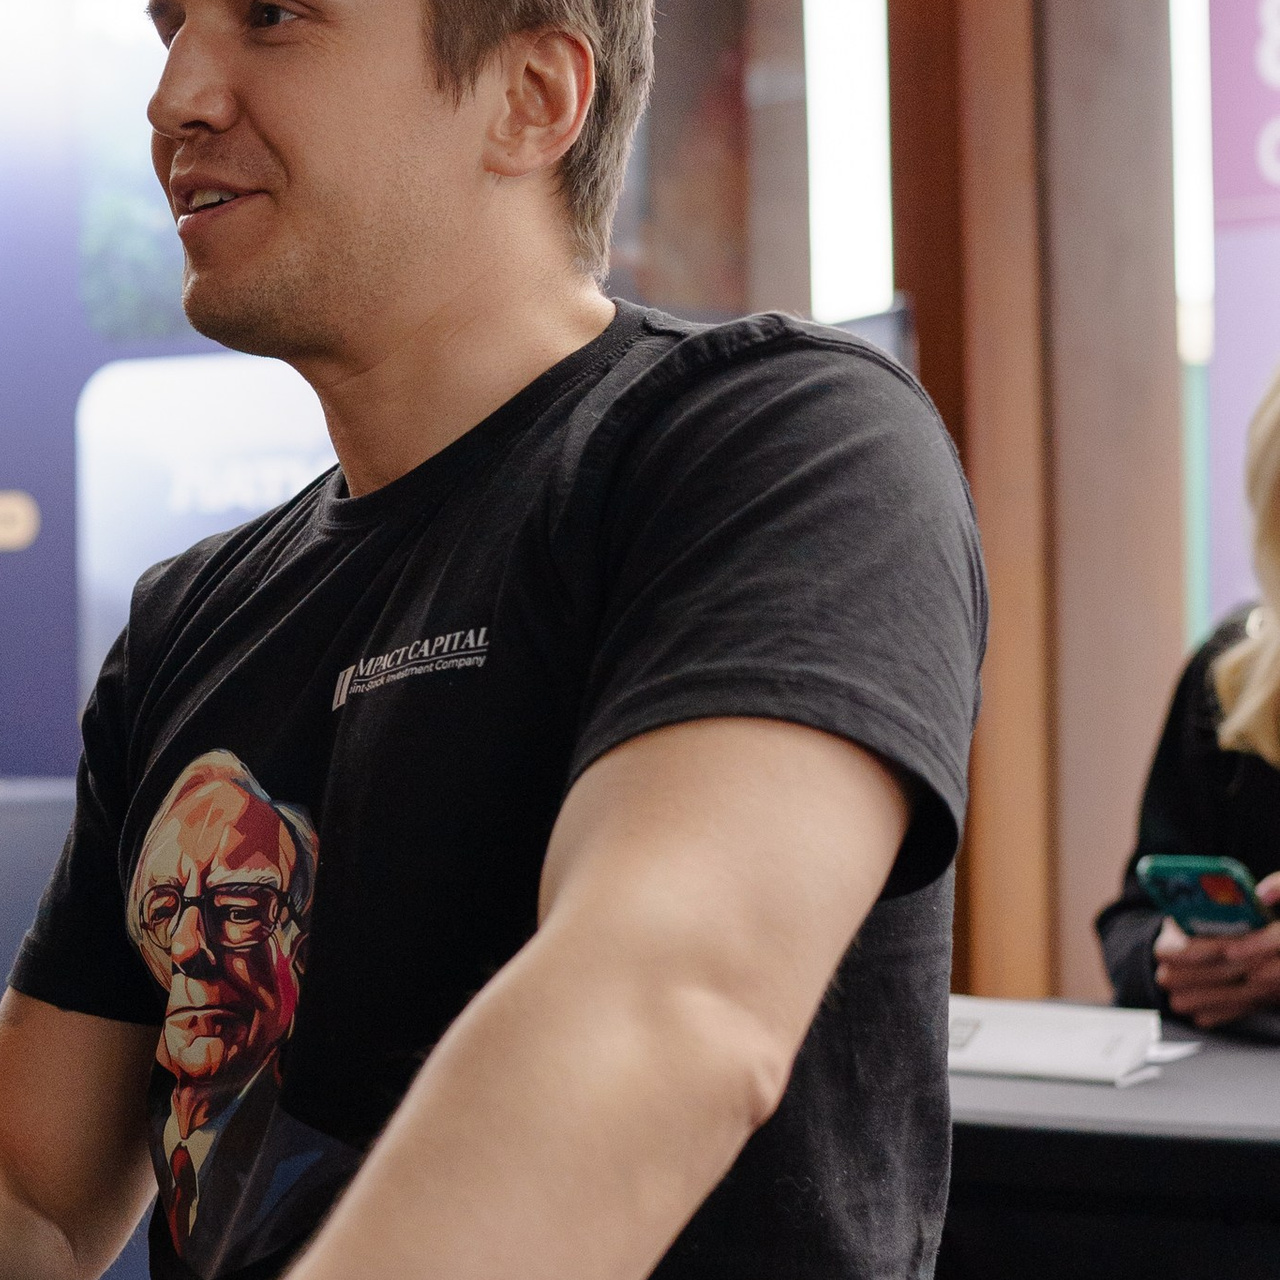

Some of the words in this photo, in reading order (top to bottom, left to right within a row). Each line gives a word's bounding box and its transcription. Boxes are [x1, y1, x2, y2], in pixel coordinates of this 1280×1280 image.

[407, 627, 489, 659] CAPITAL
[386, 663, 434, 684] Investment
[435, 655, 486, 672] Company
